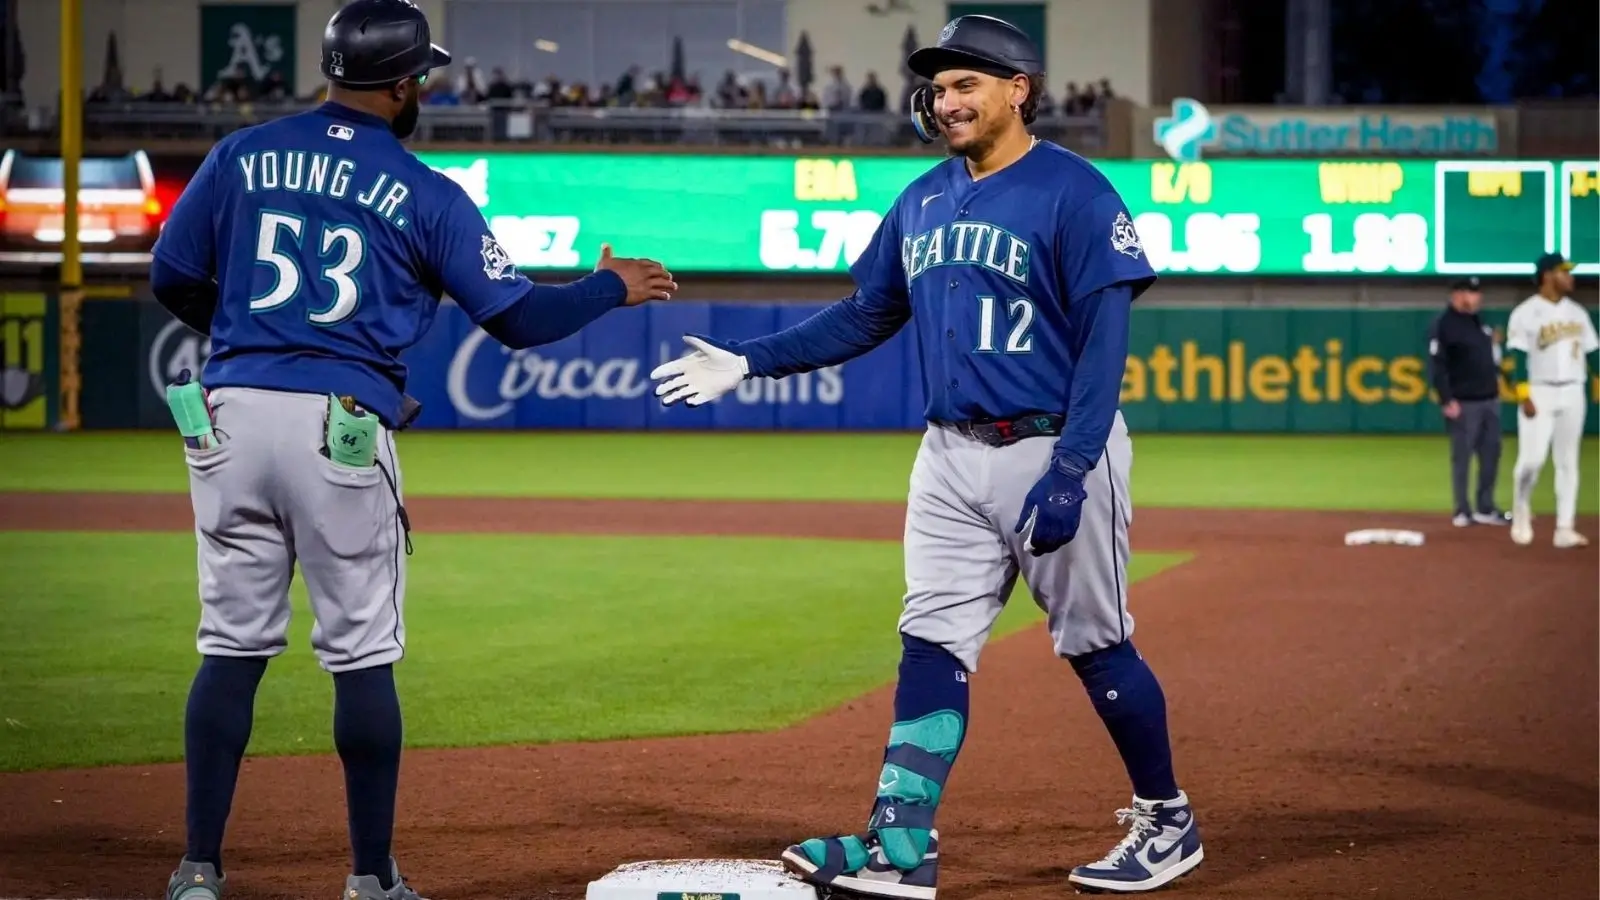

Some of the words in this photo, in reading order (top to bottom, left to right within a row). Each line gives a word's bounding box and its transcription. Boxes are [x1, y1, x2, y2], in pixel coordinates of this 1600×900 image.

[216, 22, 283, 82] A's
[1222, 113, 1349, 153] Sutter
[1357, 113, 1496, 153] Health
[238, 151, 356, 200] YOUNG
[355, 172, 410, 231] JR.
[485, 244, 507, 267] 50
[902, 221, 1030, 294] SEATTLE
[1116, 225, 1136, 242] 50
[249, 208, 367, 327] 53
[973, 295, 1035, 354] 12
[447, 326, 648, 420] Circa
[341, 434, 357, 447] 44
[885, 807, 896, 823] S
